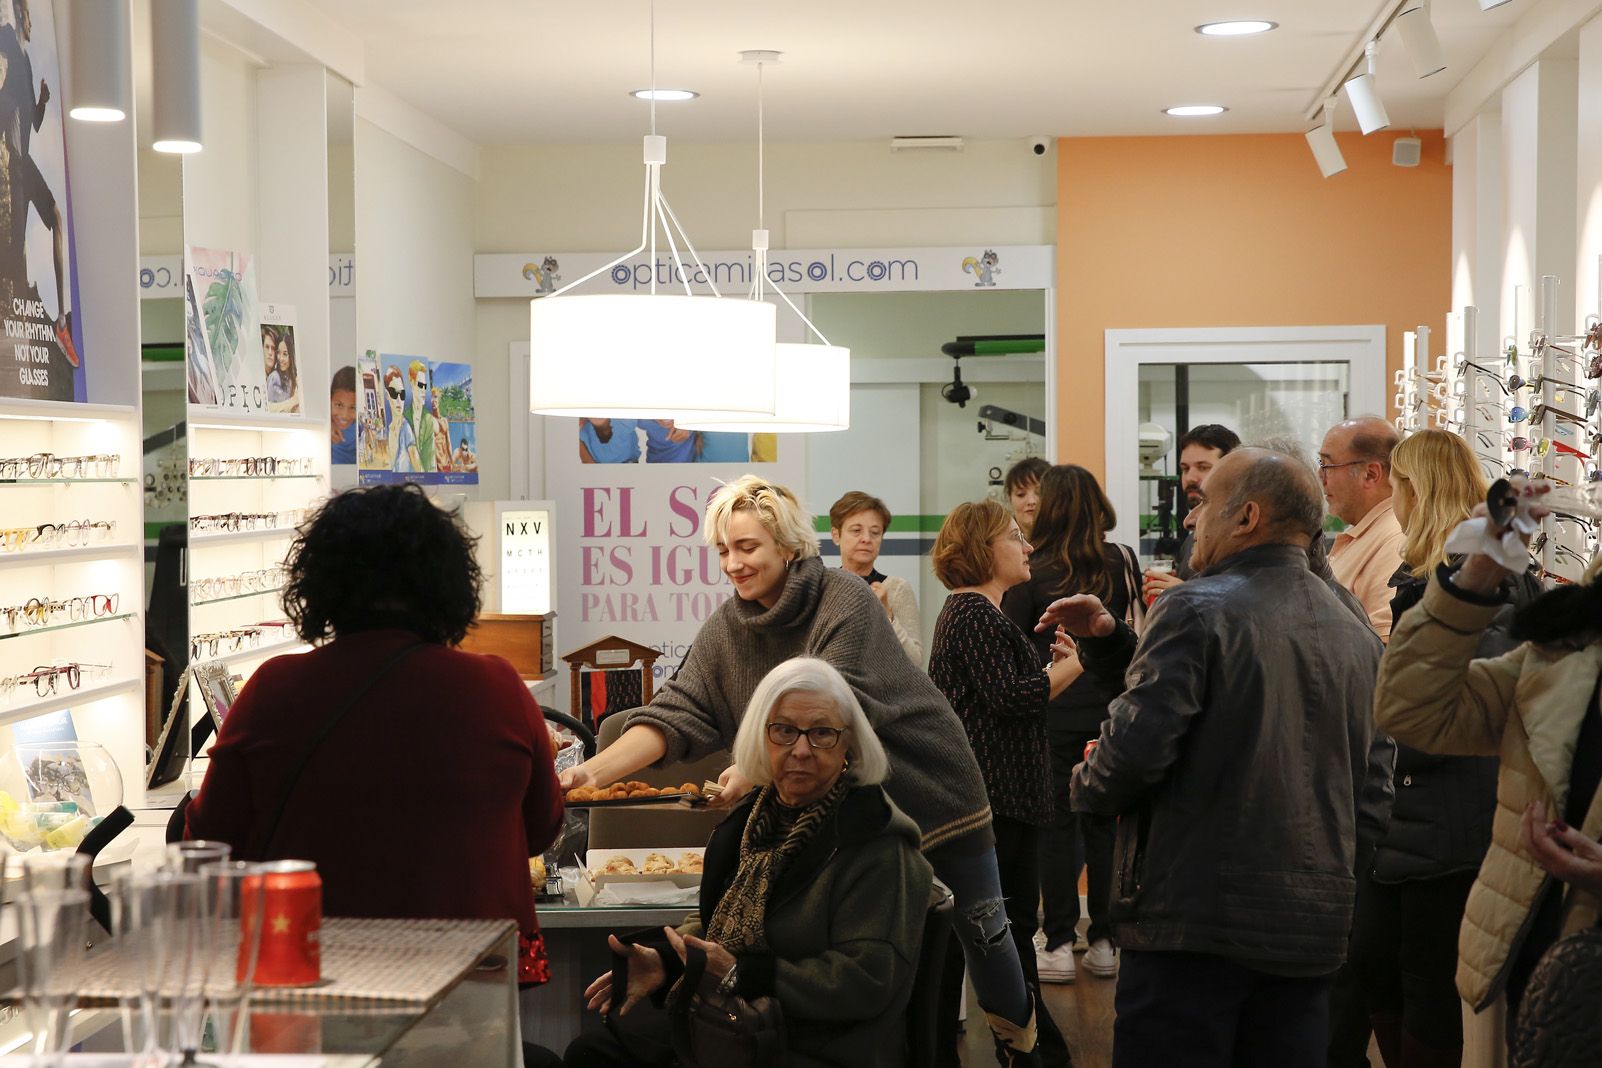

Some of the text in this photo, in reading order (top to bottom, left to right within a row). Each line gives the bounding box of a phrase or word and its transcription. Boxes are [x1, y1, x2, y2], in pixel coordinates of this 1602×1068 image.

[611, 254, 918, 290] opticamiasol.com
[13, 298, 44, 319] CHANGE
[4, 319, 56, 342] YOUR RHYTHM
[15, 344, 49, 364] NOT YOUR
[20, 367, 49, 386] GLASSES
[580, 485, 724, 538] EL S
[580, 545, 734, 586] ES IGU
[580, 592, 660, 622] PARA
